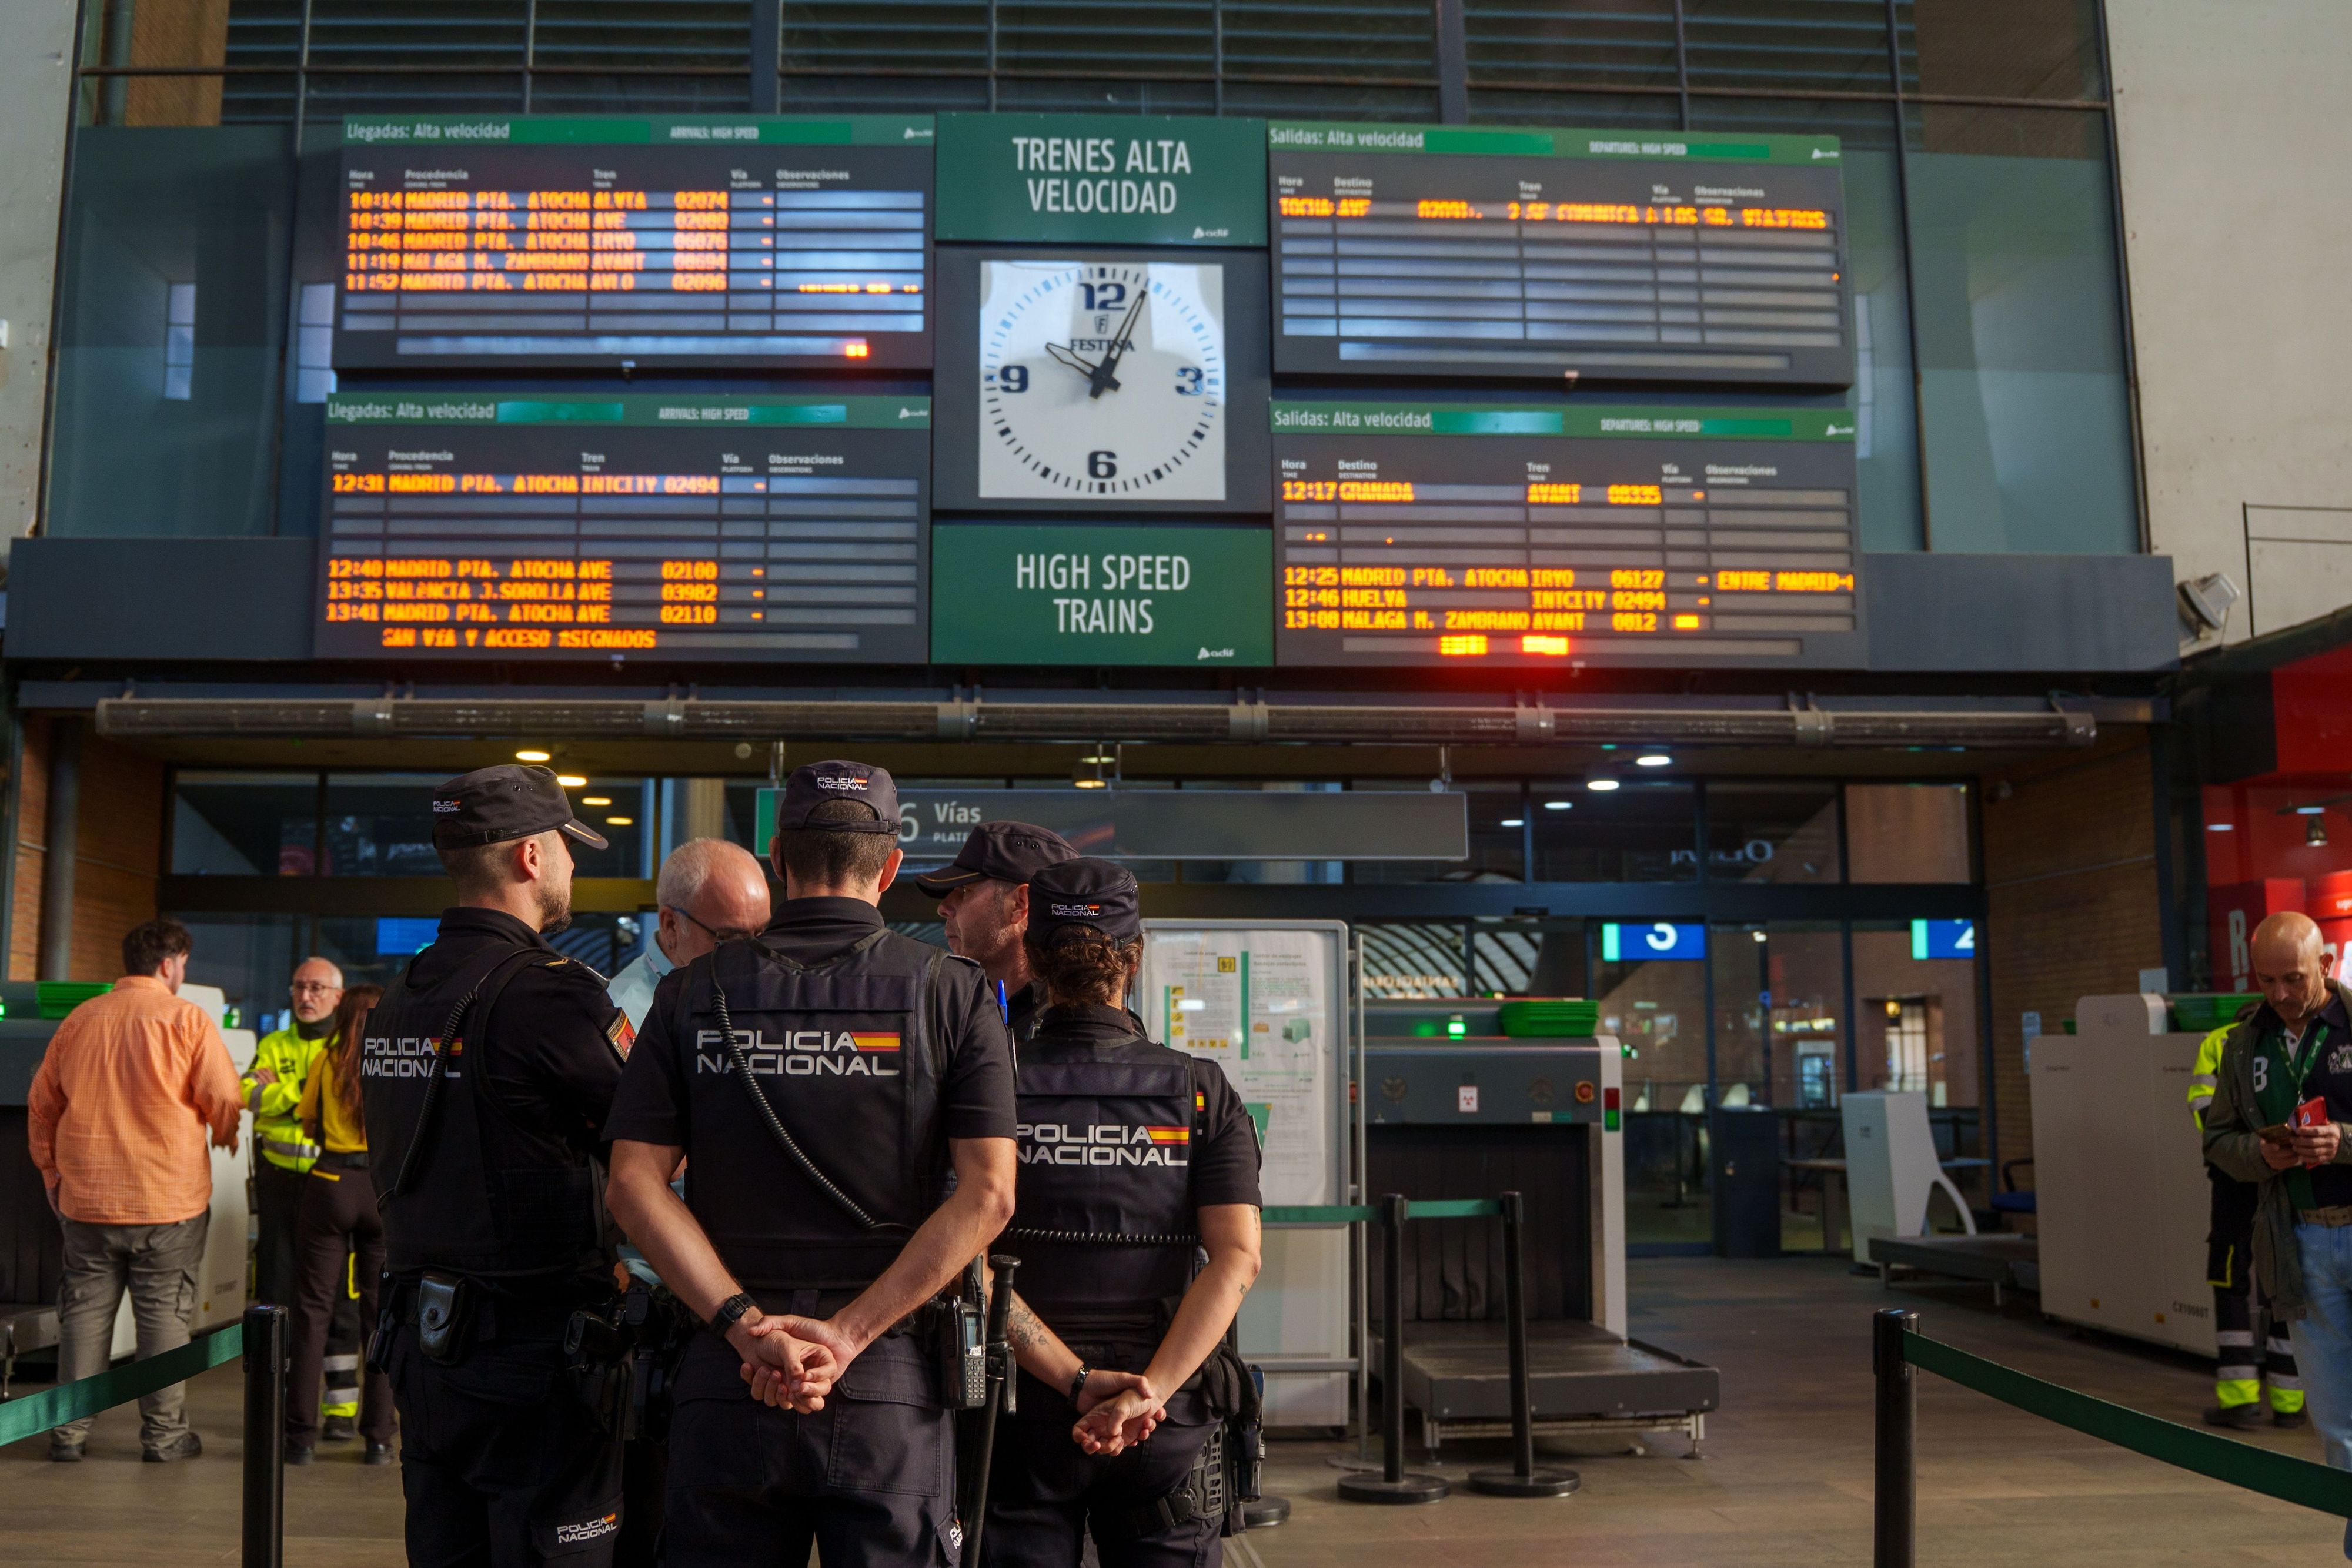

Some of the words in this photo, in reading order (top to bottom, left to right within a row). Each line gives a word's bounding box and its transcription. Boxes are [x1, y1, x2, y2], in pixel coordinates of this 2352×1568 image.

[348, 123, 410, 141] Llegadas:
[413, 123, 441, 139] Alta
[443, 123, 510, 139] velocidad
[712, 126, 732, 139] HIGH
[734, 126, 759, 139] SPEED
[1270, 128, 1324, 145] Salidas:
[1327, 129, 1354, 146] Alta
[1357, 131, 1424, 148] velocidad
[1013, 138, 1115, 172] TRENES
[1125, 139, 1191, 174] ALTA
[1641, 142, 1660, 155] HIGH
[1660, 142, 1687, 156] SPEED
[1334, 177, 1373, 188] Destino
[405, 192, 470, 210] MADRID
[527, 191, 592, 210] ATOCHA
[1027, 178, 1176, 213] VELOCIDAD
[405, 212, 469, 230] MADRID
[526, 212, 591, 230] ATOCHA
[593, 212, 627, 230] AVE
[402, 232, 469, 250] MADRID
[525, 232, 590, 250] ATOCHA
[400, 273, 466, 290] MADRID
[523, 273, 588, 290] ATOCHA
[1079, 282, 1127, 310] 12
[1070, 338, 1135, 352] FESTINA
[1000, 365, 1029, 393] 9
[1175, 366, 1205, 396] 3
[328, 403, 393, 422] Llegadas:
[395, 402, 424, 420] Alta
[427, 402, 495, 420] velocidad
[658, 408, 699, 420] ARRIVALS:
[701, 408, 722, 420] HIGH
[724, 408, 749, 421] SPEED
[1275, 410, 1328, 427] Salidas:
[1333, 412, 1359, 427] Alta
[1364, 413, 1431, 429] velocidad
[1601, 418, 1652, 432] DEPARTURES:
[1653, 419, 1672, 432] HIGH
[1673, 419, 1700, 433] SPEED
[332, 451, 358, 462] Hora
[388, 450, 454, 462] Procedencia
[582, 452, 606, 463] Tren
[769, 454, 844, 466] Observaciones
[1087, 450, 1117, 479] 6
[1282, 460, 1306, 470] Hora
[1338, 460, 1377, 471] Destino
[1527, 462, 1551, 473] Tren
[1705, 464, 1778, 476] Observaciones
[332, 474, 386, 493] 12:31
[387, 474, 456, 493] MADRID
[513, 475, 579, 493] ATOCHA
[1282, 481, 1338, 501] 12:17
[385, 560, 452, 579] MADRID
[457, 560, 499, 579] PTA.
[509, 560, 576, 579] ATOCHA
[577, 560, 613, 580] AVE
[662, 561, 719, 581] 02100
[1017, 554, 1090, 589] HIGH
[1102, 554, 1190, 591] SPEED
[1284, 567, 1339, 586] 12:25
[1341, 567, 1407, 587] MADRID
[1412, 568, 1455, 587] PTA.
[1465, 568, 1529, 587] ATOCHA
[1530, 569, 1575, 588] IRYO
[1717, 571, 1771, 590] ENTRE
[328, 580, 384, 600] 13:35
[577, 582, 613, 601] AVE
[1285, 588, 1340, 607] 12:46
[1341, 589, 1408, 608] HUELVA
[1612, 591, 1666, 610] 02494
[326, 603, 380, 622] 13:41
[383, 603, 450, 622] MADRID
[456, 603, 499, 622] PTA.
[508, 603, 574, 622] ATOCHA
[576, 604, 612, 623] AVE
[660, 604, 717, 624] 02110
[1053, 598, 1154, 634] TRAINS
[1445, 610, 1531, 630] ZAMBRANO
[1531, 611, 1586, 631] AVANT
[464, 628, 479, 647] Y
[484, 628, 552, 648] ACCESO
[1210, 648, 1234, 658] adif
[934, 800, 981, 823] Vías
[2253, 1055, 2269, 1093] B
[1017, 1145, 1188, 1166] NACIONAL
[558, 1523, 617, 1544] NACIONAL
